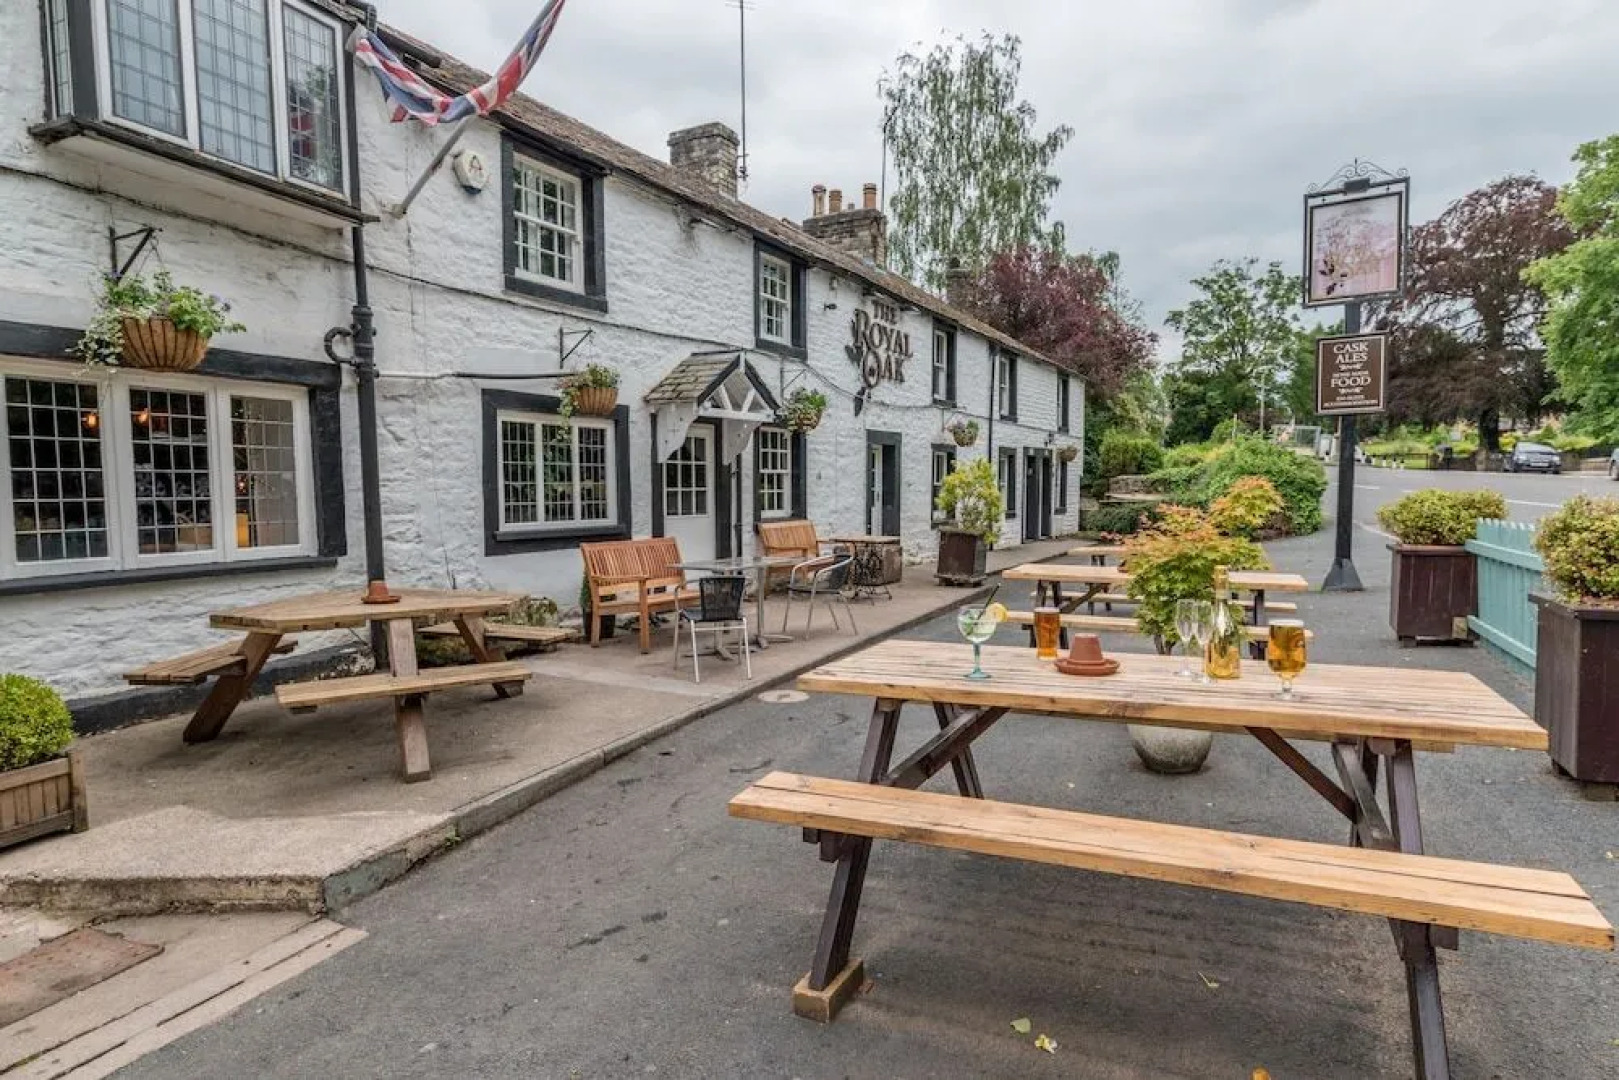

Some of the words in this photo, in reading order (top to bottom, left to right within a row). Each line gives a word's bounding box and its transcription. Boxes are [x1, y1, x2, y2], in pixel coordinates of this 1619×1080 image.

[871, 299, 898, 325] THE
[852, 308, 913, 359] ROYAL
[1333, 342, 1369, 354] CASK
[1335, 352, 1368, 363] ALES
[863, 350, 905, 388] OAK
[1331, 376, 1372, 388] FOOD
